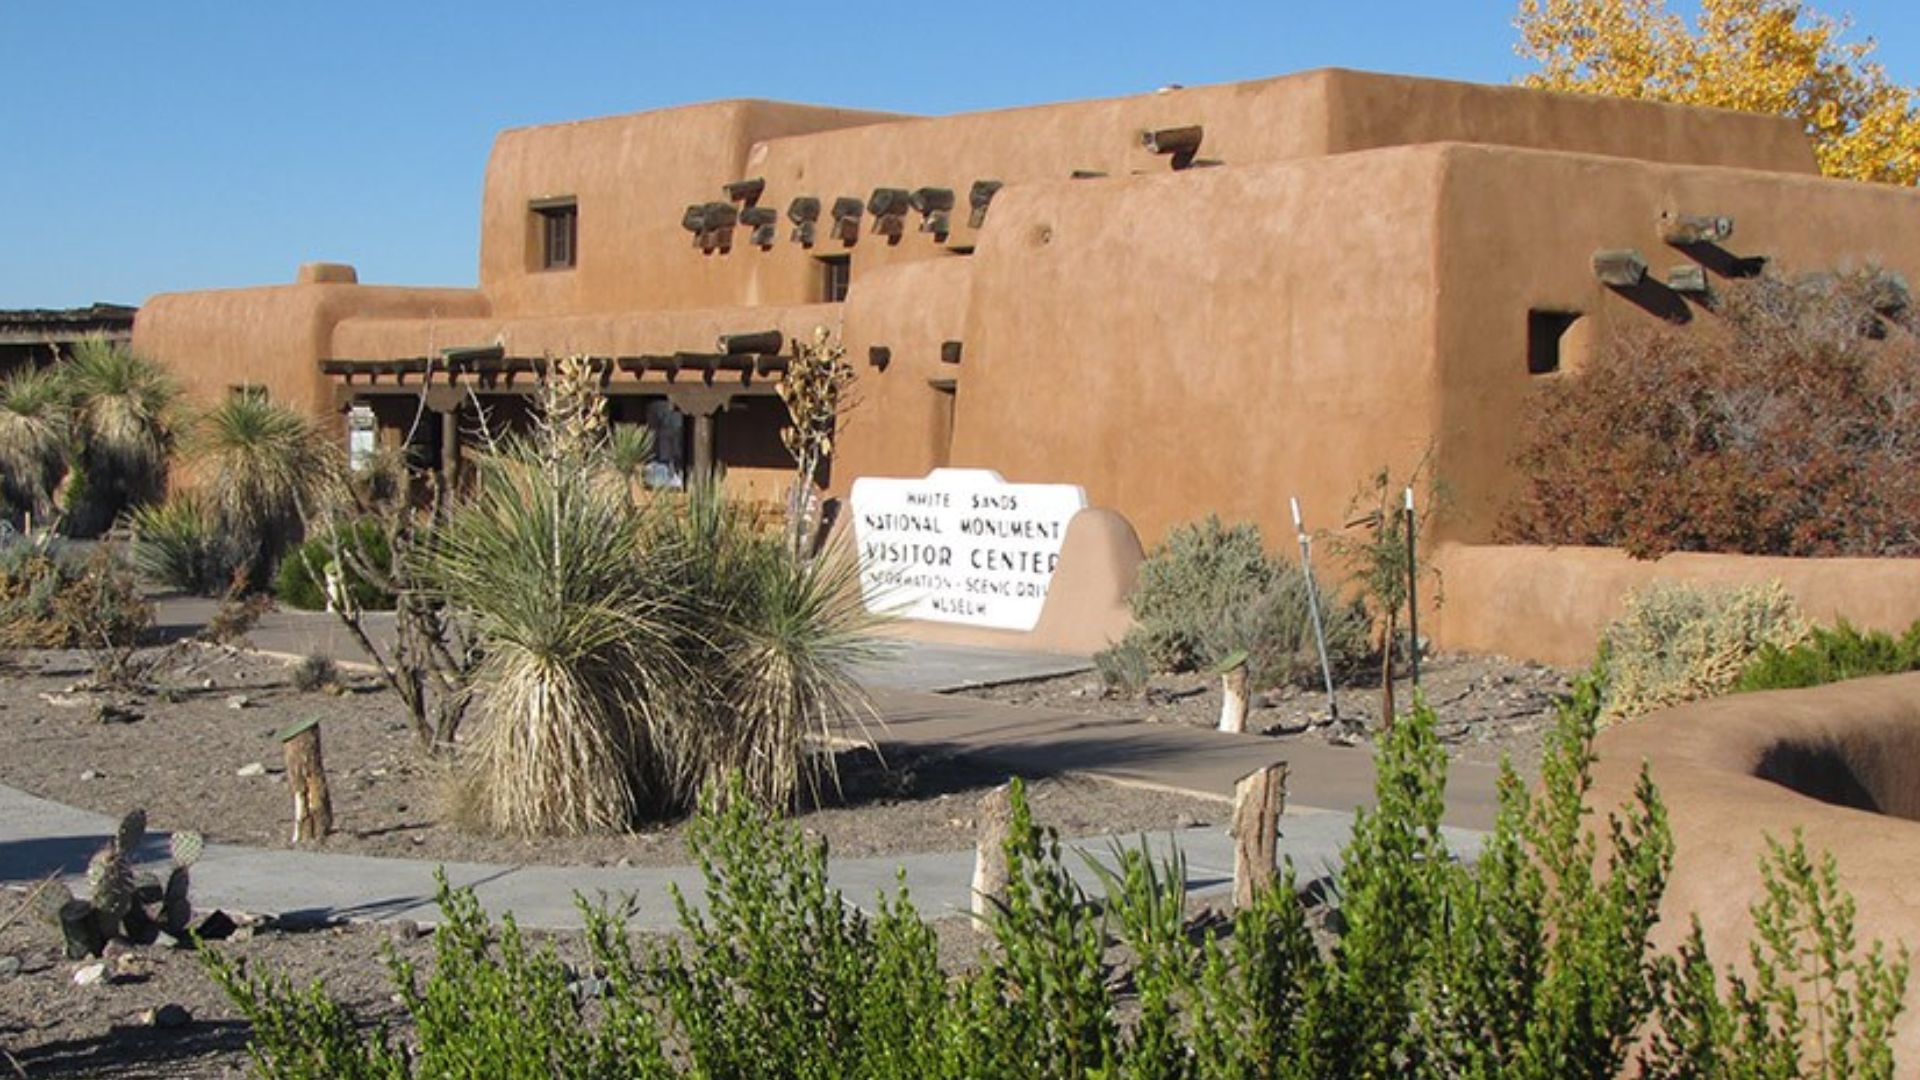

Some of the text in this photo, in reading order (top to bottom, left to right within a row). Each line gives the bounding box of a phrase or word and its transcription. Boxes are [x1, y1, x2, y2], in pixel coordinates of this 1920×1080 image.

[906, 492, 1017, 510] WHITE SANDS
[865, 513, 1059, 539] NATIONAL MONUMENT
[866, 541, 1060, 574] VISITOR CENTER
[864, 570, 951, 589] NFORMATION
[965, 577, 1010, 597] SCENIC
[931, 596, 986, 615] MUSEUM
